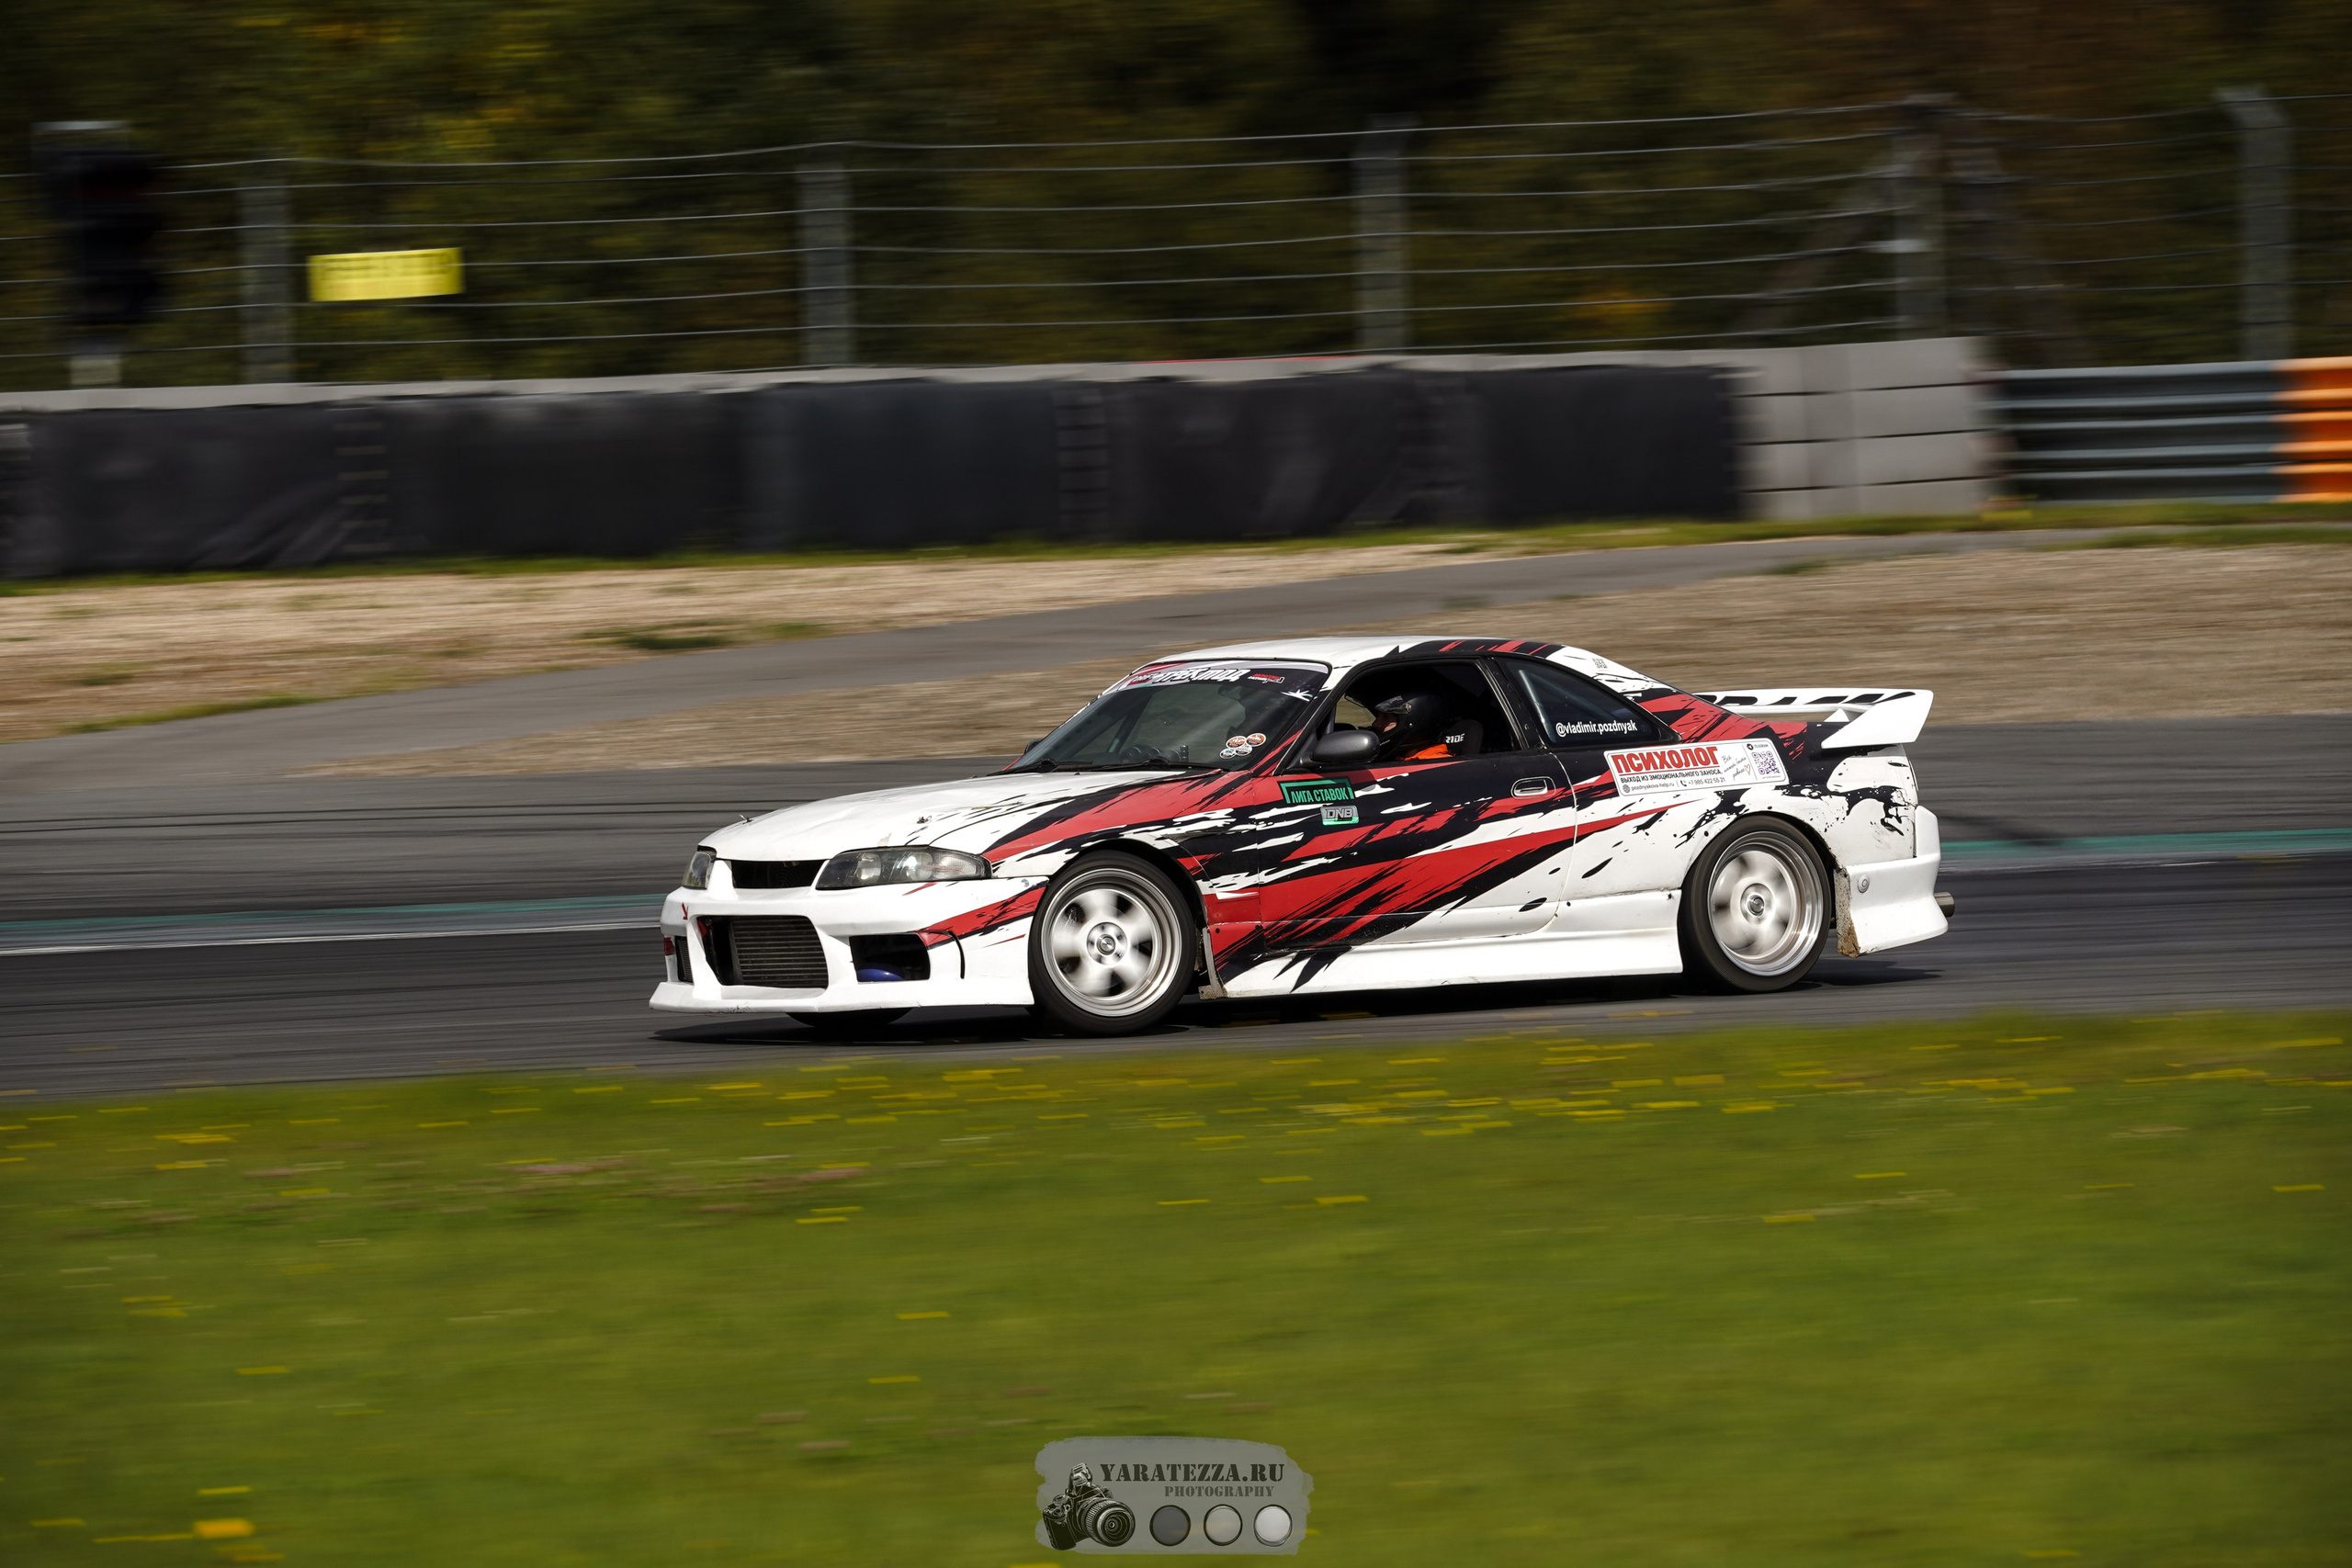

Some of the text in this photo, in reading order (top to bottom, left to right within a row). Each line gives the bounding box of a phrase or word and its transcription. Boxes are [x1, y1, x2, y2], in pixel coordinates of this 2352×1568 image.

[1555, 719, 1638, 738] @vladimir.pozdnyak
[1611, 746, 1718, 773] ПСИХОЛОГ
[1620, 775, 1641, 784] ВЫХОД
[1650, 770, 1700, 781] ЭМОЦИОНАЛЬНОГО
[1631, 782, 1675, 792] pozdnyakova-help.ru
[1290, 787, 1349, 804] ЛИГА СТАВОК
[1327, 807, 1353, 818] DNB
